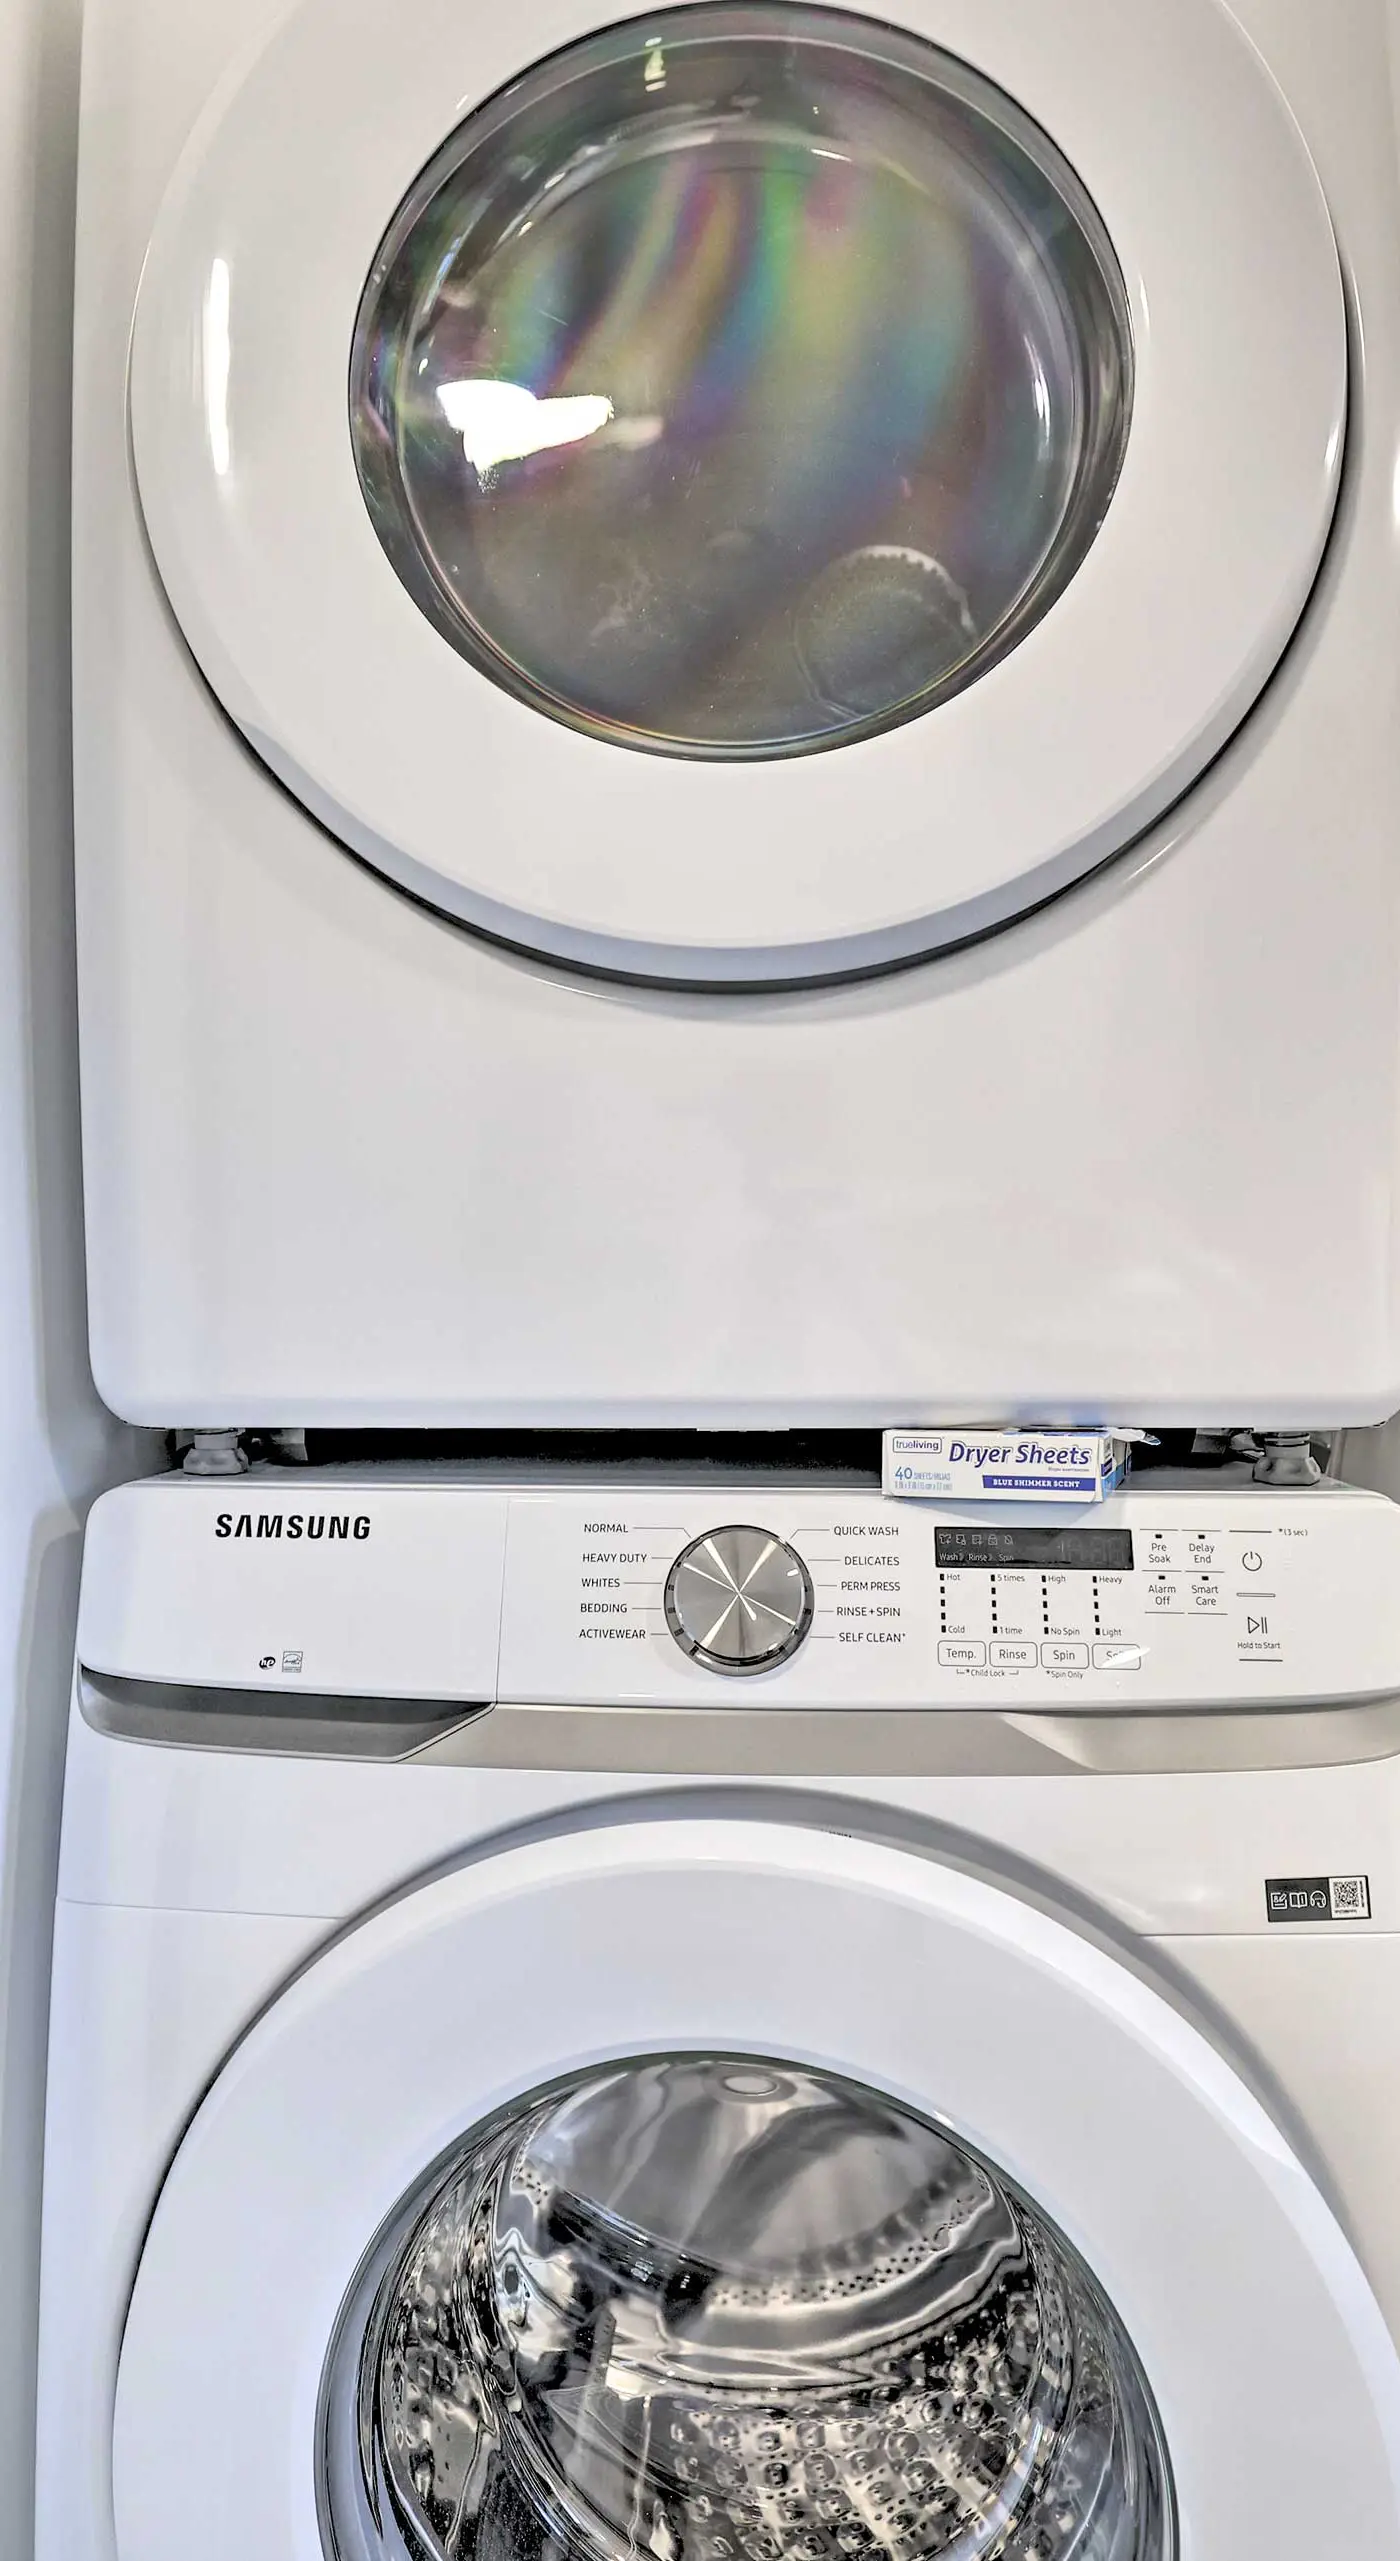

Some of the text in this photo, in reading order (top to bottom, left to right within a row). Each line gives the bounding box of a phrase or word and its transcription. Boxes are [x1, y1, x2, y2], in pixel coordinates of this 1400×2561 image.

[949, 1442, 1090, 1468] Dryer Sheets
[895, 1466, 913, 1480] 40
[1014, 1479, 1052, 1487] SHIMMER
[1054, 1480, 1080, 1488] SCENT
[215, 1514, 371, 1540] SAMSUNG
[584, 1524, 628, 1533] NORMAL
[834, 1526, 899, 1536] QUICK WASH
[1151, 1543, 1167, 1552] Pre
[1189, 1543, 1215, 1553] Delay
[582, 1553, 647, 1563] HEAVY DUTY
[845, 1556, 900, 1566] DELICATES
[1149, 1554, 1170, 1563] Soak
[1194, 1555, 1211, 1563] End
[582, 1578, 620, 1587] WHITES
[1048, 1575, 1066, 1583] High
[1099, 1576, 1122, 1584] Heavy
[841, 1582, 901, 1591] PERM PRESS
[1149, 1585, 1176, 1593] Alarm
[1192, 1585, 1218, 1594] Smart
[1155, 1597, 1170, 1605] Off
[1196, 1597, 1216, 1605] Care
[580, 1603, 627, 1613] BEDDING
[836, 1607, 867, 1616] RINSE
[877, 1607, 901, 1617] SPIN
[579, 1629, 646, 1639] ACTIVEWEAR
[839, 1633, 863, 1642] SELF
[1102, 1629, 1121, 1637] Light
[947, 1648, 976, 1659] Temp.
[999, 1649, 1027, 1659] Rinse
[1053, 1650, 1075, 1661] Spin
[1067, 1671, 1083, 1679] Only
